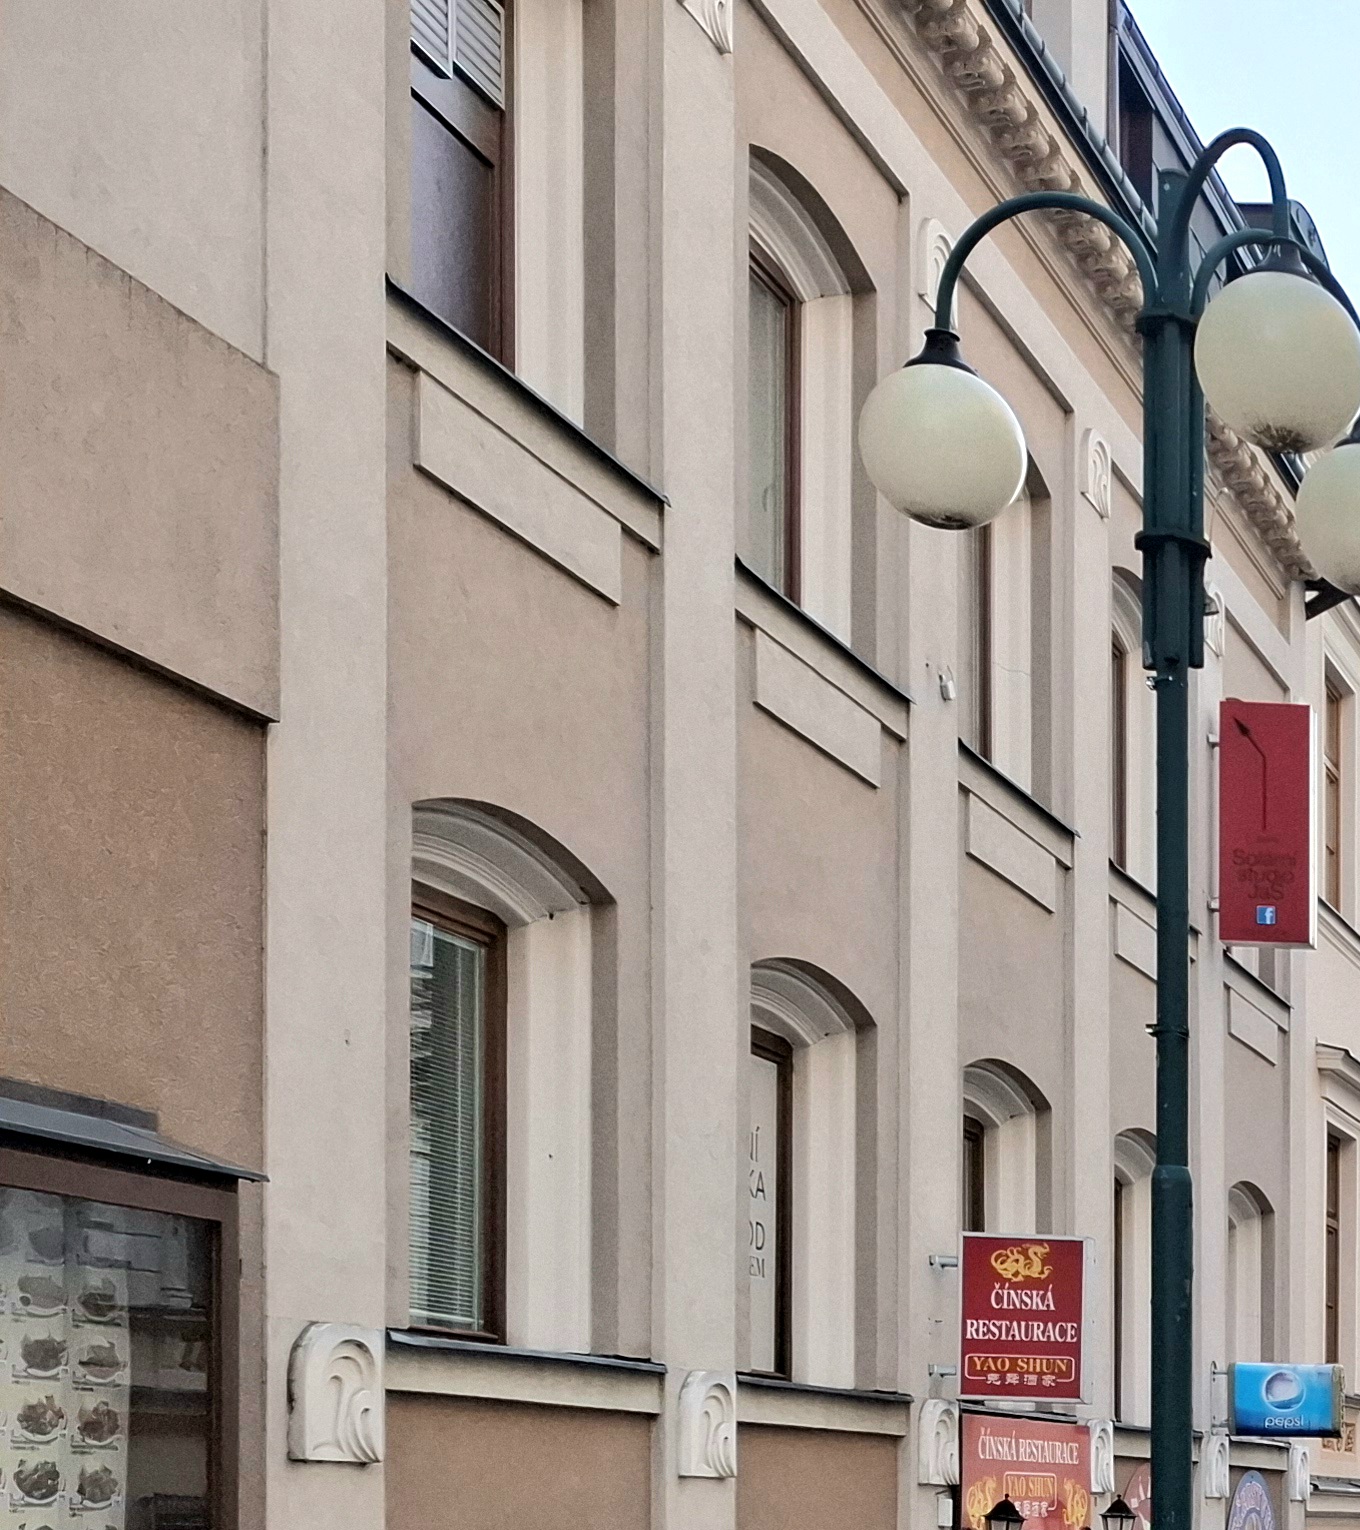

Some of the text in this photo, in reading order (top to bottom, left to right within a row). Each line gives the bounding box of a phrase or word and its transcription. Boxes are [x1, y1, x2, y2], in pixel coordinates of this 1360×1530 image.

[991, 1282, 1056, 1311] ČÍNSKÁ
[966, 1319, 1077, 1342] RESTAURACE
[973, 1356, 1067, 1373] YAO SHUN
[1264, 1415, 1305, 1429] pepsi
[978, 1427, 1080, 1465] ČÍNSKÁ RESTAURACE
[1007, 1476, 1054, 1498] YAO SHUN
